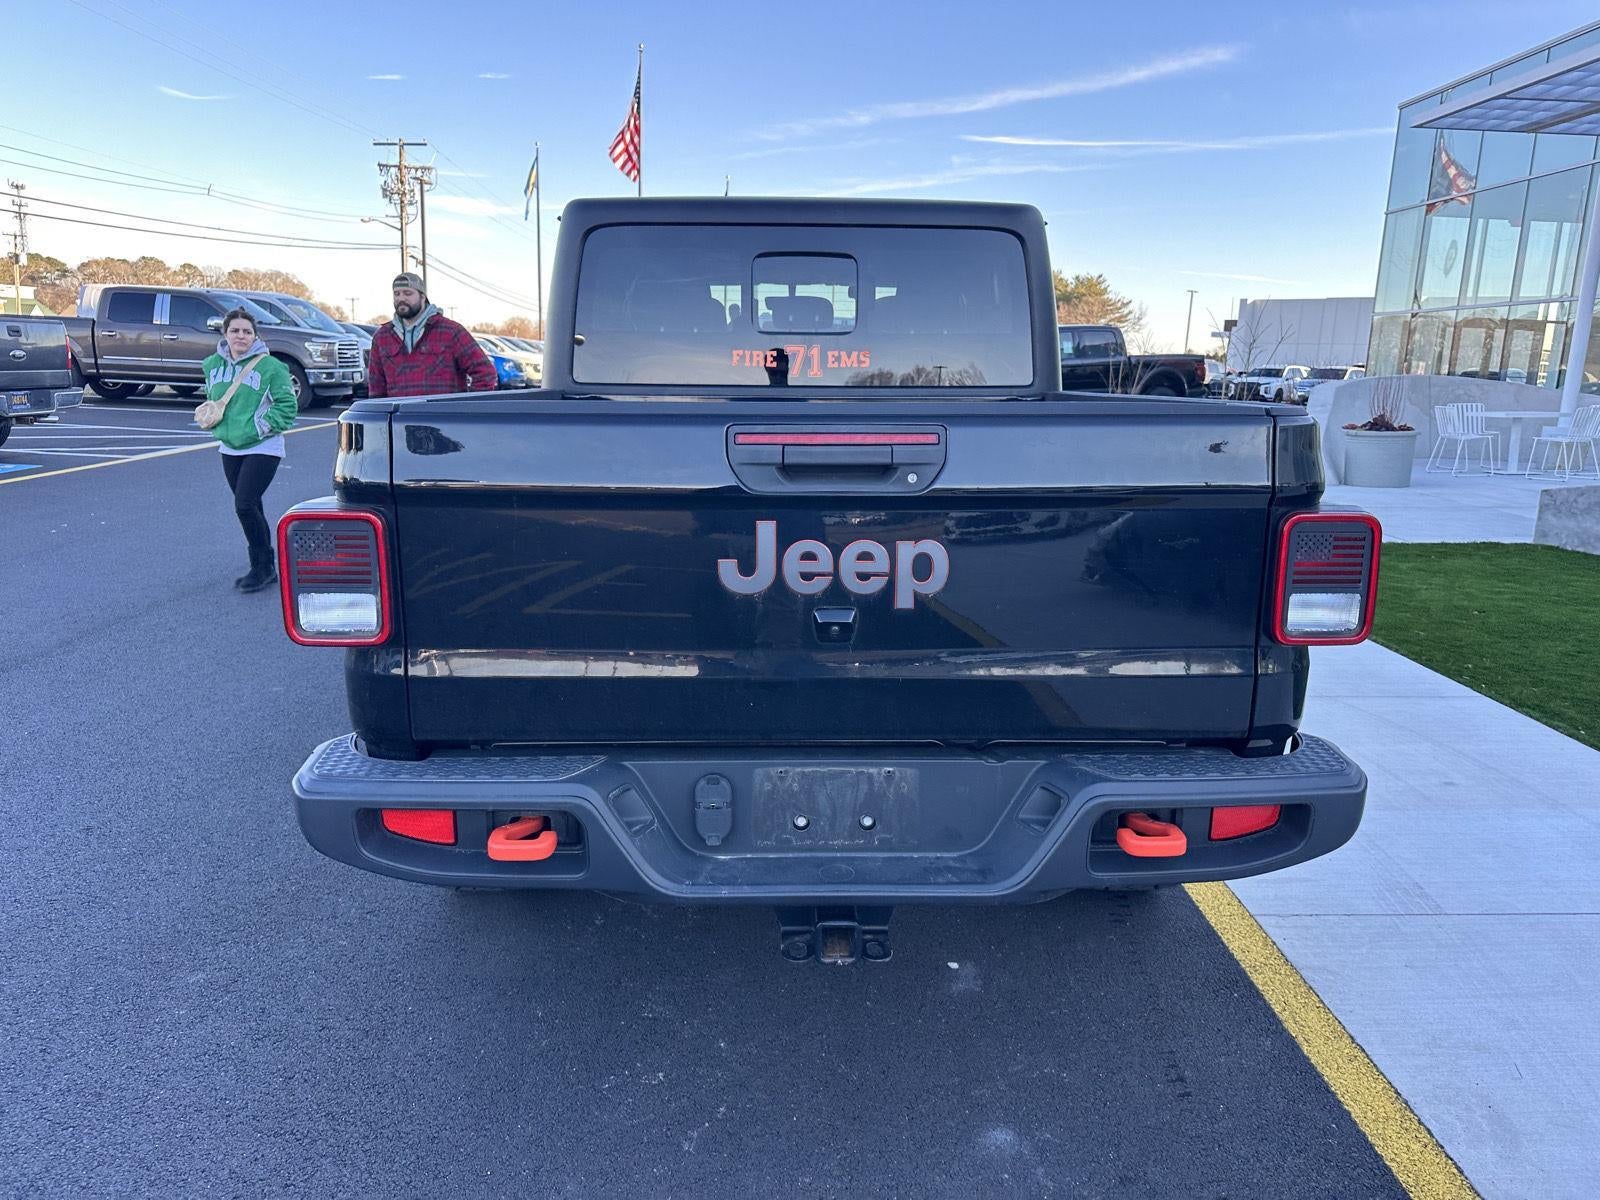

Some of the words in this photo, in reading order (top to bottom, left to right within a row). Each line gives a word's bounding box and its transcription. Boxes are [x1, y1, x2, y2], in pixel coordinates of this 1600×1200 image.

[731, 349, 777, 368] FIRE
[784, 344, 823, 377] 71
[827, 350, 871, 368] EMS
[717, 520, 950, 610] Jeep
